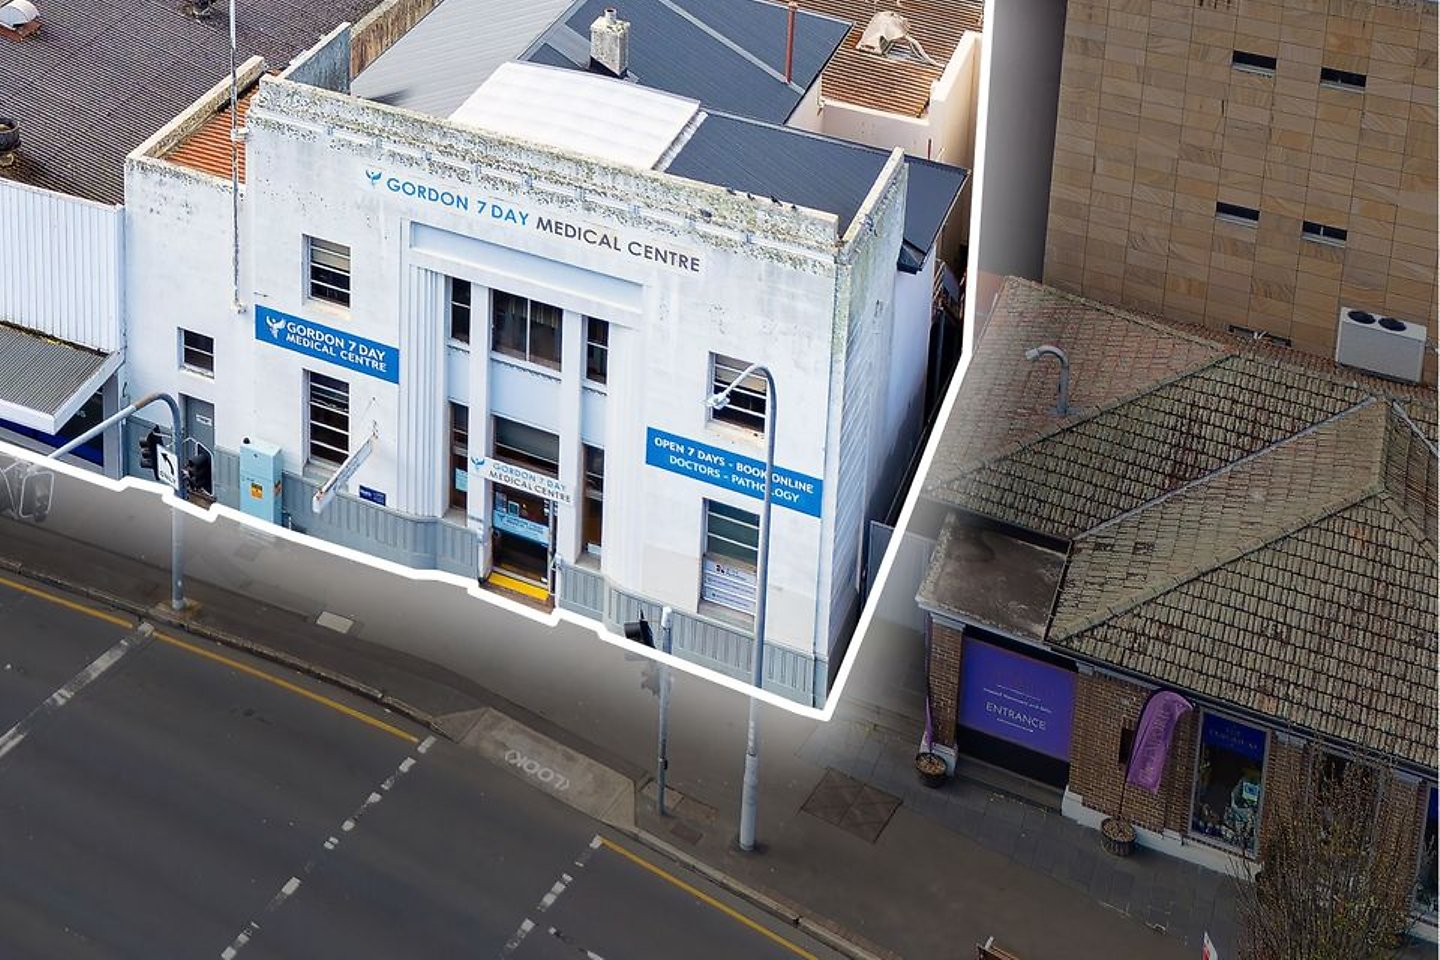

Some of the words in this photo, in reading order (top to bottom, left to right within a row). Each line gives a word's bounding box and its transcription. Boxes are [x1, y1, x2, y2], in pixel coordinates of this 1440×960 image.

[386, 177, 469, 211] GORDON
[477, 200, 487, 215] 7
[491, 204, 529, 226] DAY
[536, 216, 622, 252] MEDICAL
[627, 240, 701, 272] CENTRE
[286, 321, 345, 349] GORDON
[349, 341, 356, 351] 7
[359, 345, 386, 362] DAY
[286, 332, 337, 357] MEDICAL
[340, 350, 387, 373] CENTRE
[492, 462, 537, 483] GORDON
[547, 480, 566, 492] DAY
[654, 437, 685, 454] OPEN
[688, 446, 695, 457] 7
[697, 450, 726, 467] DAYS
[735, 461, 768, 480] BOOK
[771, 473, 814, 494] ONLINE
[669, 455, 721, 479] DOCTORS
[731, 474, 800, 503] PATHOOGY
[489, 470, 533, 492] MEDICAL
[534, 485, 571, 504] CENTRE
[986, 701, 1047, 731] ENTRANCE
